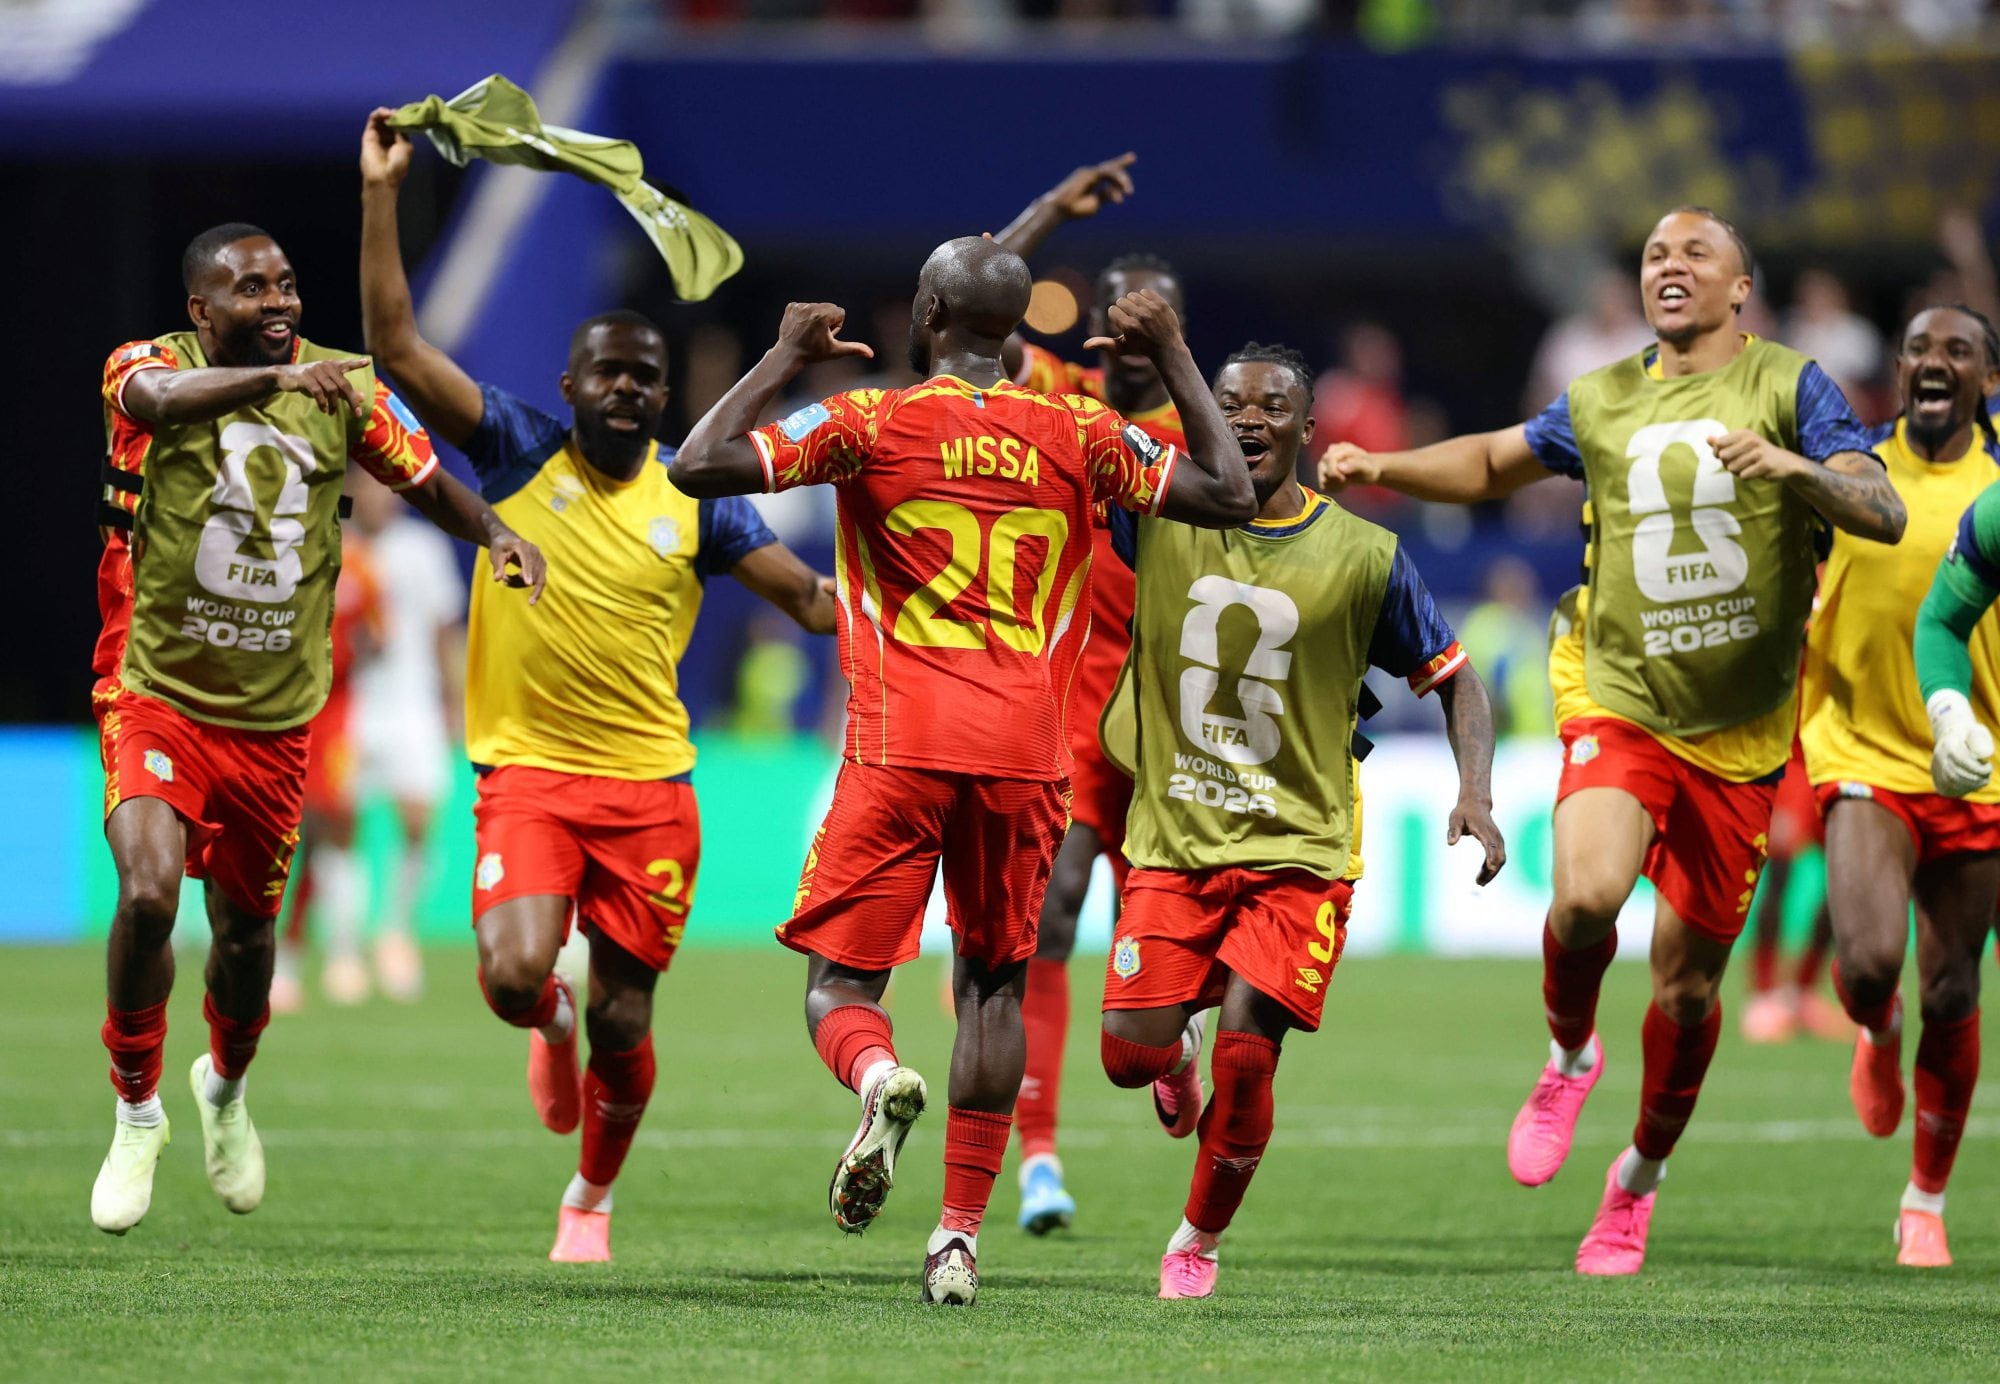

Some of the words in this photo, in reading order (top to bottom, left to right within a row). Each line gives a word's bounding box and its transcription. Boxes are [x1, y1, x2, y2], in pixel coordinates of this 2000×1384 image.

[940, 436, 1039, 487] WISSA
[227, 563, 278, 587] FIFA
[885, 500, 1069, 658] 20
[1666, 562, 1719, 584] FIFA
[186, 596, 259, 623] WORLD
[261, 610, 296, 626] CUP
[1640, 604, 1712, 628] WORLD
[1715, 597, 1756, 616] CUP
[180, 615, 292, 652] 2026
[1643, 615, 1760, 657] 2026
[1202, 722, 1249, 748] FIFA
[1174, 752, 1236, 783] WORLD
[1238, 772, 1277, 791] CUP
[1168, 774, 1277, 819] 2026
[1308, 900, 1337, 963] 9
